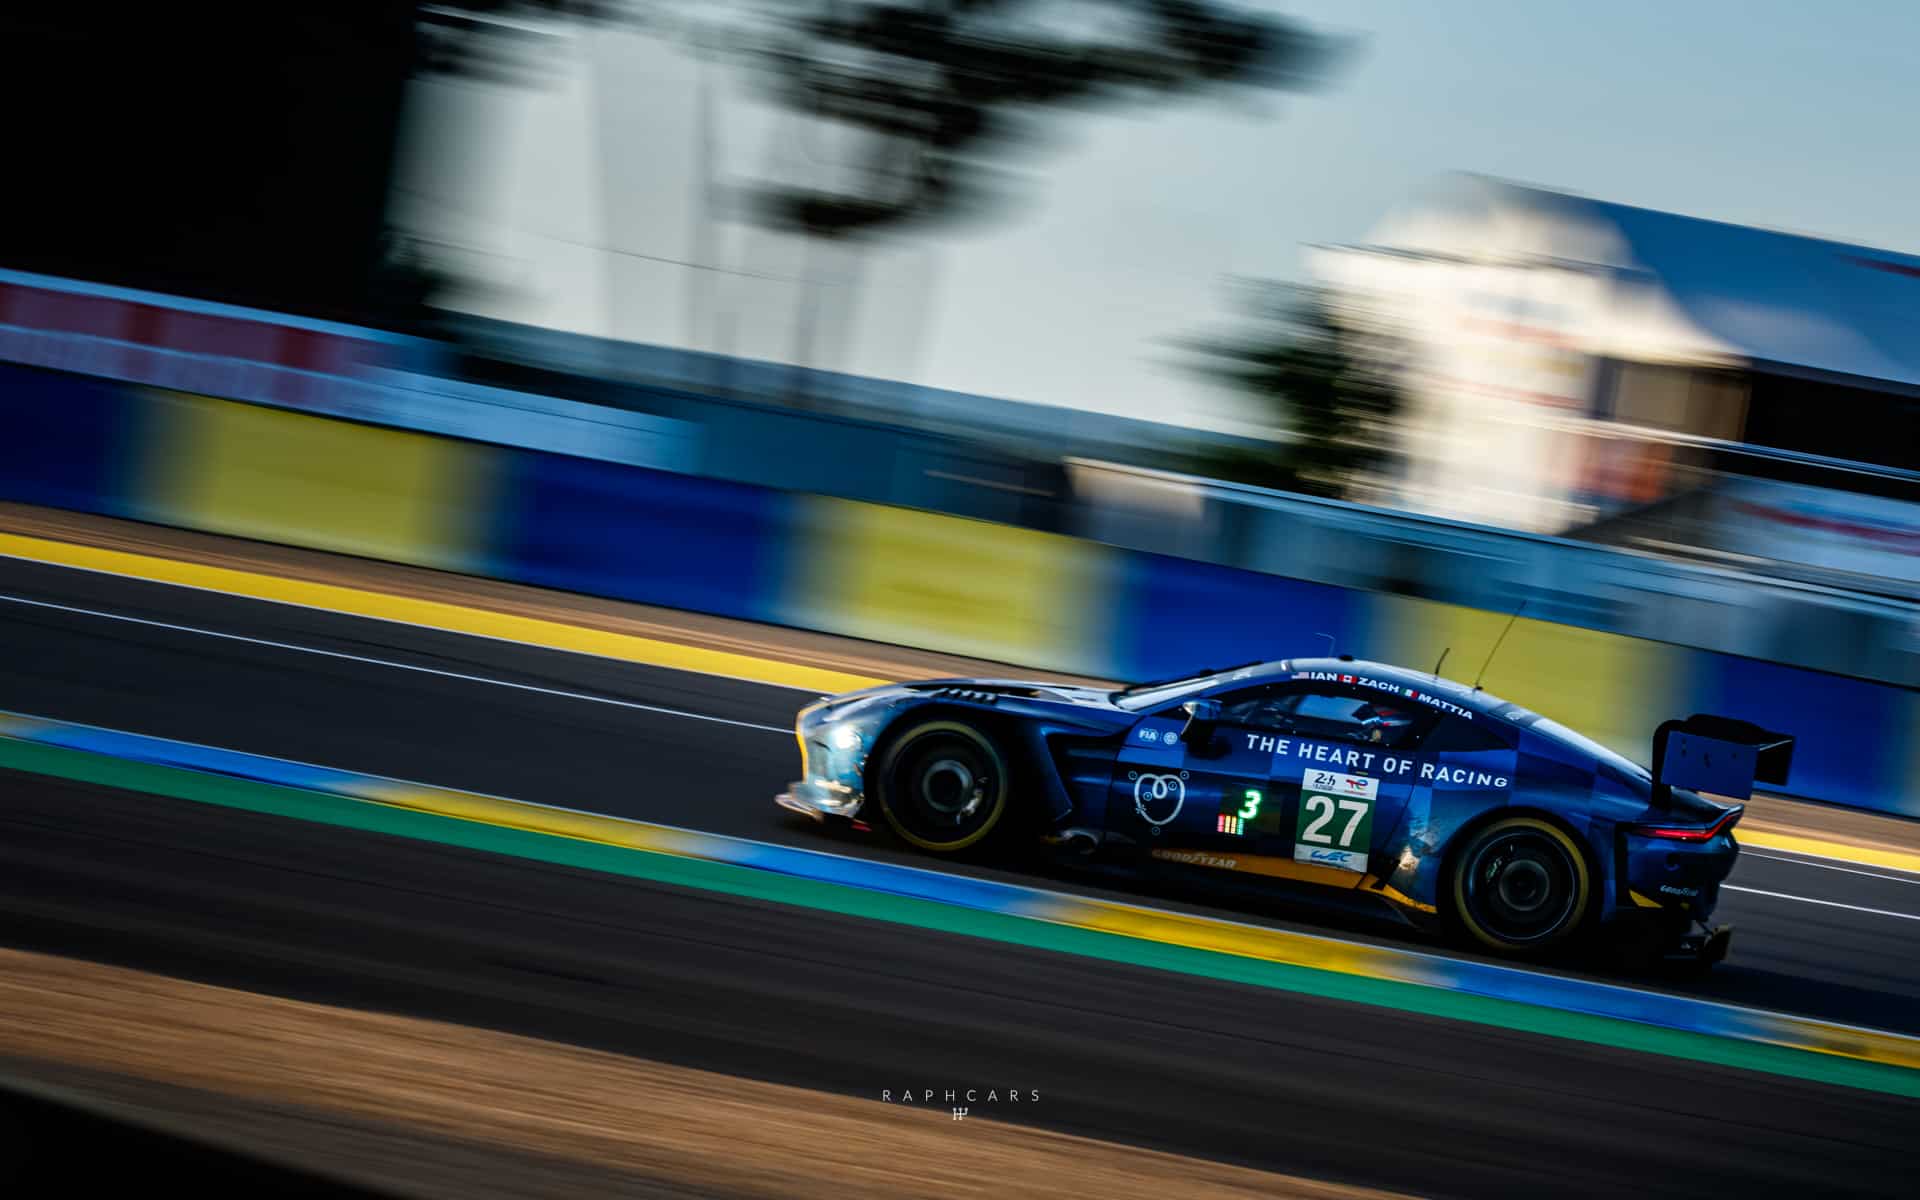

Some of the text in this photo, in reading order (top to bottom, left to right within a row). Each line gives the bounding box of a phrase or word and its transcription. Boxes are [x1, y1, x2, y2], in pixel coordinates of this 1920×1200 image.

[1310, 671, 1473, 720] IAN ZACH MATTIA
[1247, 733, 1508, 788] THE HEART OF RACING
[1237, 789, 1262, 820] 3
[1302, 795, 1369, 847] 27
